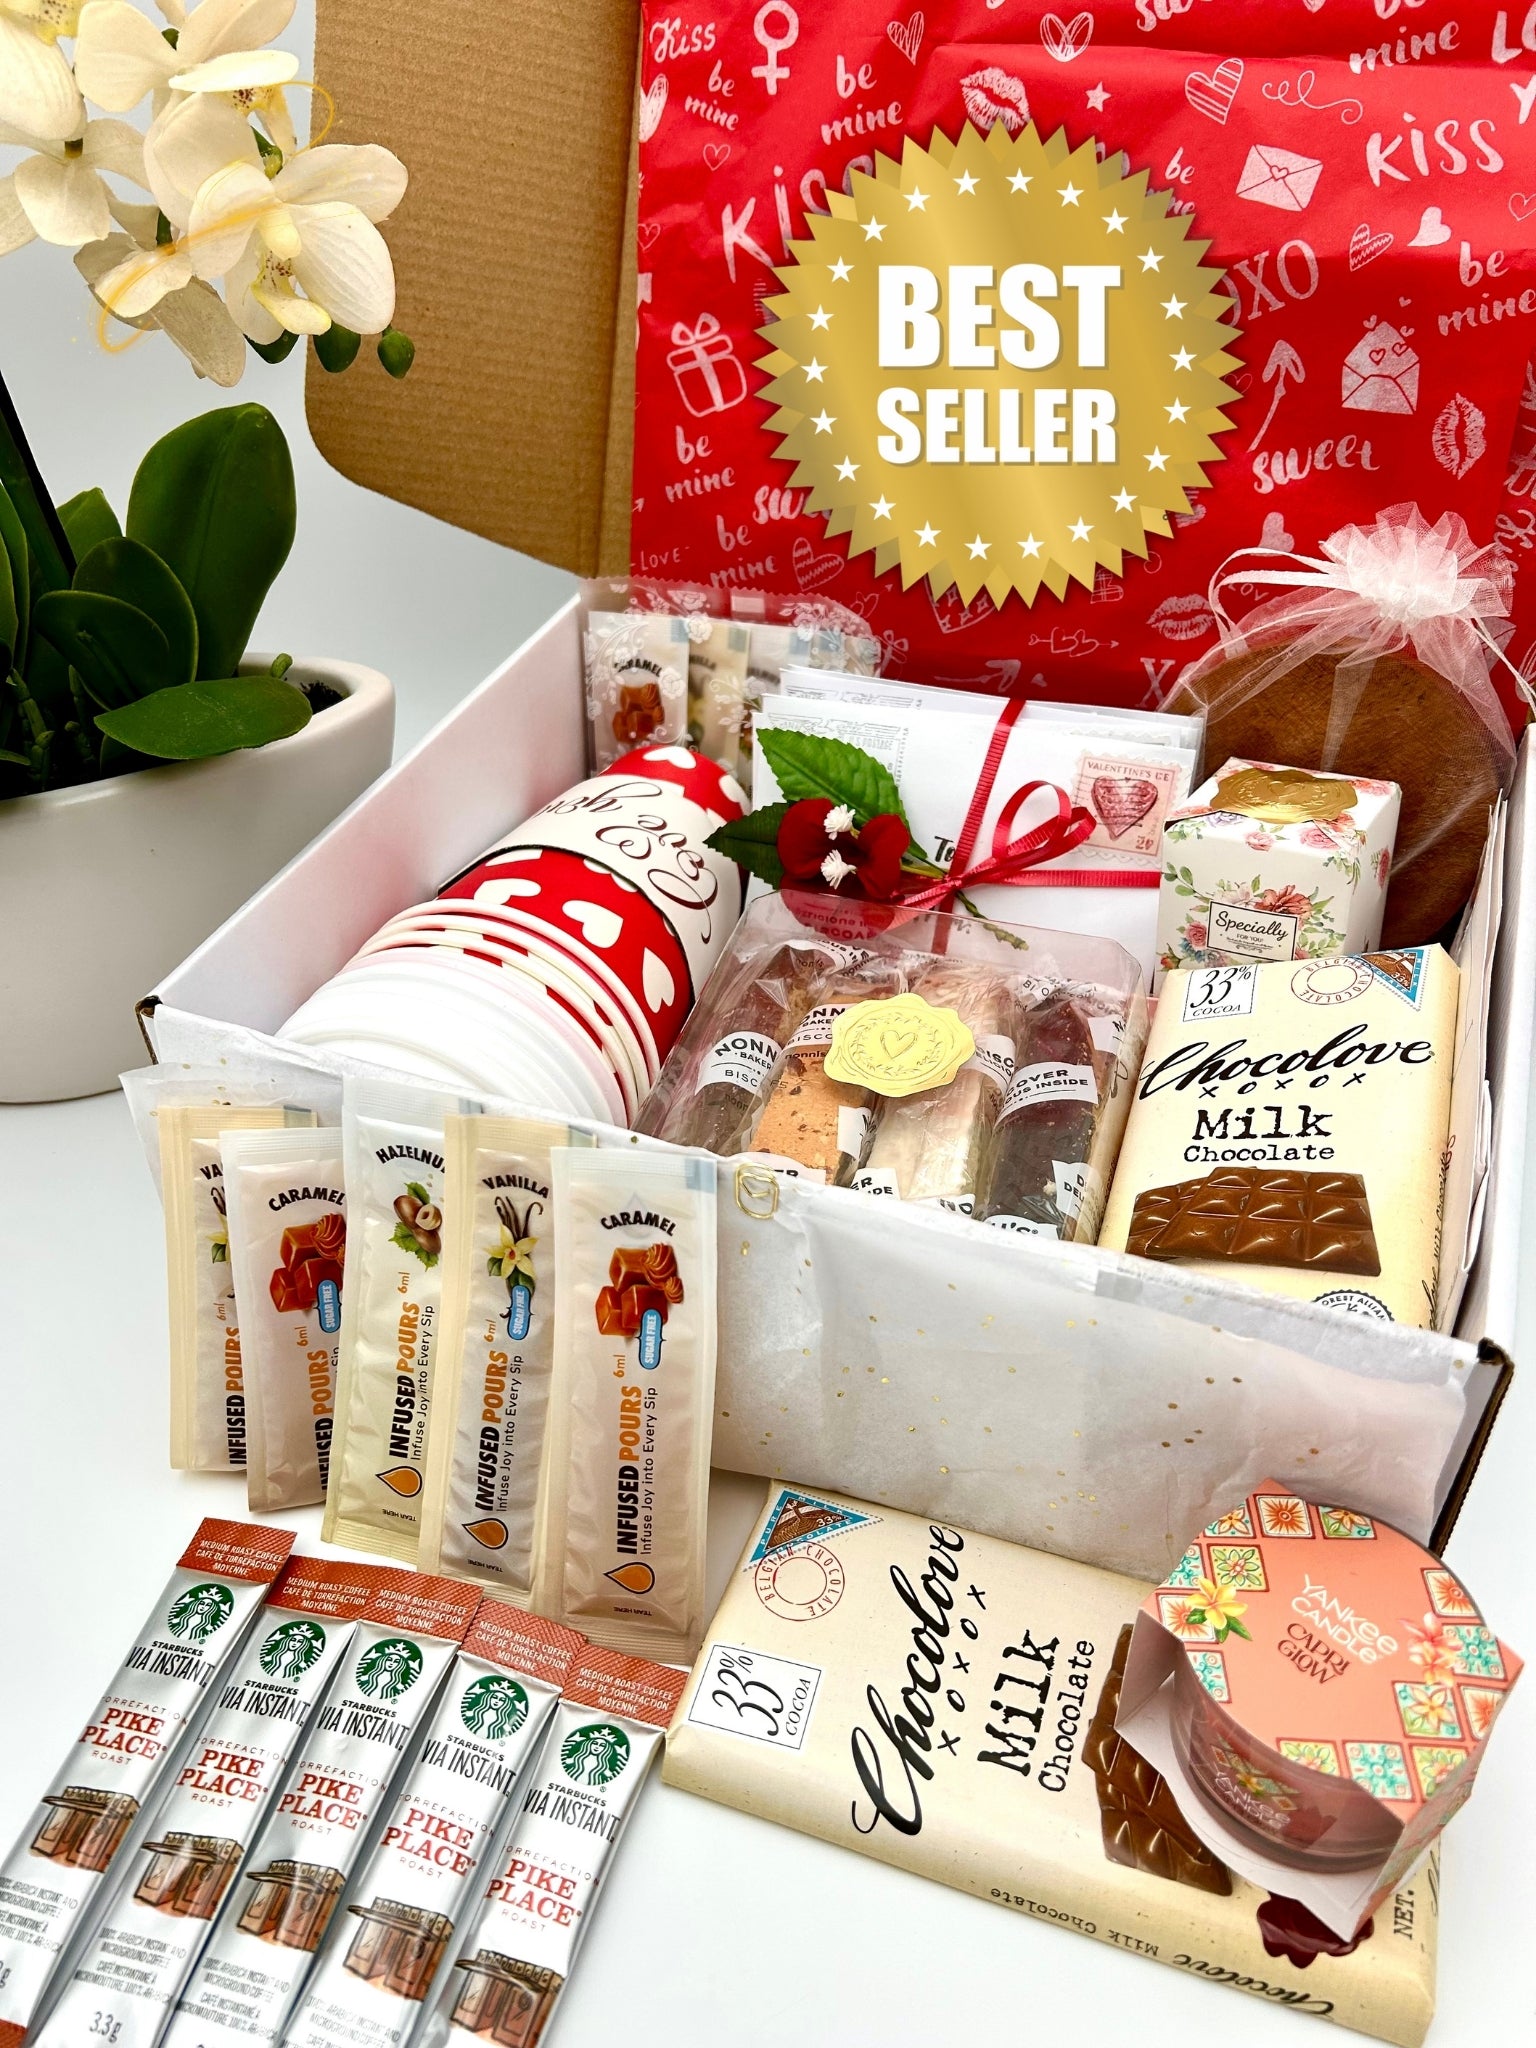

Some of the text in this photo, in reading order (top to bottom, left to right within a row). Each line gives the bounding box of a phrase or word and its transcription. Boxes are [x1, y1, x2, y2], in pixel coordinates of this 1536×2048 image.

[650, 17, 716, 63] Kiss
[1349, 21, 1460, 74] mine
[707, 60, 735, 97] be
[837, 55, 877, 99] be
[685, 94, 739, 130] mine
[821, 101, 904, 145] mine
[1165, 147, 1195, 184] be
[1459, 241, 1510, 287] be
[1437, 287, 1536, 337] mine
[676, 425, 712, 465] be
[1252, 434, 1380, 495] sweet
[665, 466, 736, 502] mine
[716, 514, 752, 552] be
[710, 552, 779, 589] mine
[1216, 911, 1288, 941] Specially
[1189, 964, 1251, 1009] 33%
[1192, 1003, 1242, 1018] COCOA
[714, 1037, 781, 1064] NONN
[740, 1052, 772, 1070] BAKER
[1139, 1023, 1432, 1101] Chocolove
[724, 1068, 760, 1088] BISC
[1035, 1078, 1089, 1090] INSIDE
[1192, 1105, 1333, 1141] Milk
[375, 1144, 447, 1174] HAZELNU
[1183, 1145, 1335, 1163] Chocolate
[268, 1187, 346, 1212] CARAMEL
[482, 1174, 549, 1198] VANILLA
[600, 1210, 677, 1237] CARAMEL
[397, 1271, 410, 1294] 6ml
[213, 1302, 227, 1321] 6ml
[324, 1284, 336, 1328] SUGAR FREE
[512, 1290, 525, 1335] SUGAR FREE
[1321, 1295, 1354, 1306] OREST
[294, 1326, 308, 1347] 6ml
[483, 1319, 497, 1343] 6ml
[645, 1314, 657, 1363] SUGAR FREE
[389, 1301, 421, 1458] INFUSED POURS
[613, 1354, 626, 1378] 6ml
[224, 1326, 247, 1465] INFUSED POURS
[306, 1349, 332, 1415] POURS
[410, 1304, 435, 1461] Infuse Joy into Every Sip
[474, 1349, 509, 1512] INFUSED POURS
[496, 1355, 523, 1512] Infuse Joy into Every Sip
[616, 1385, 642, 1555] INFUSED POURS
[639, 1386, 658, 1556] Infuse Joy into Every Sip
[760, 1505, 782, 1545] PURE
[200, 1540, 283, 1562] MEDIUM ROAST COFFEE
[214, 1552, 224, 1560] DE
[214, 1563, 250, 1575] MOYENNE
[759, 1545, 841, 1616] BELGIAN CHOCOLATE
[287, 1577, 371, 1596] MEDIUM ROAST COFFEE
[302, 1600, 338, 1611] MOYENNE
[380, 1589, 467, 1615] MEDIUM ROAST COFFEE
[395, 1604, 406, 1612] DE
[396, 1615, 435, 1629] MOYENNE
[151, 1640, 204, 1656] STARBUCKS
[480, 1621, 572, 1660] MEDIUM ROAST COFFEE
[497, 1639, 508, 1647] DE
[1287, 1622, 1350, 1676] CAPRI
[125, 1646, 153, 1670] VIA
[498, 1650, 537, 1670] MOYENNE
[1277, 1639, 1336, 1685] GLOW
[243, 1679, 300, 1696] STARBUCKS
[580, 1668, 673, 1700] MEDIUM ROAST COFFEE
[598, 1684, 608, 1694] DE
[712, 1650, 784, 1736] 33%
[850, 1525, 965, 1836] Chocolove
[218, 1685, 248, 1709] VIA
[341, 1699, 397, 1718] STARBUCKS
[598, 1696, 638, 1713] MOYENNE
[785, 1678, 811, 1736] COCOA
[976, 1629, 1060, 1778] Milk
[100, 1707, 165, 1736] PIKE
[316, 1705, 346, 1729] VIA
[1037, 1639, 1095, 1793] Chocolate
[92, 1751, 132, 1765] ROAST
[420, 1739, 446, 1765] VIA
[446, 1734, 505, 1762] STARBUCKS
[196, 1748, 266, 1779] PIKE
[191, 1793, 233, 1809] ROAST
[296, 1773, 365, 1805] PIKE
[522, 1789, 549, 1815] VIA
[546, 1782, 608, 1807] STARBUCKS
[290, 1819, 332, 1836] ROAST
[403, 1807, 475, 1851] PIKE
[399, 1856, 444, 1880] ROAST
[504, 1858, 577, 1901] PIKE
[501, 1908, 547, 1932] ROAST
[1393, 1889, 1415, 1941] NET.
[990, 1887, 1335, 2021] Chocolove Milk Chocolate
